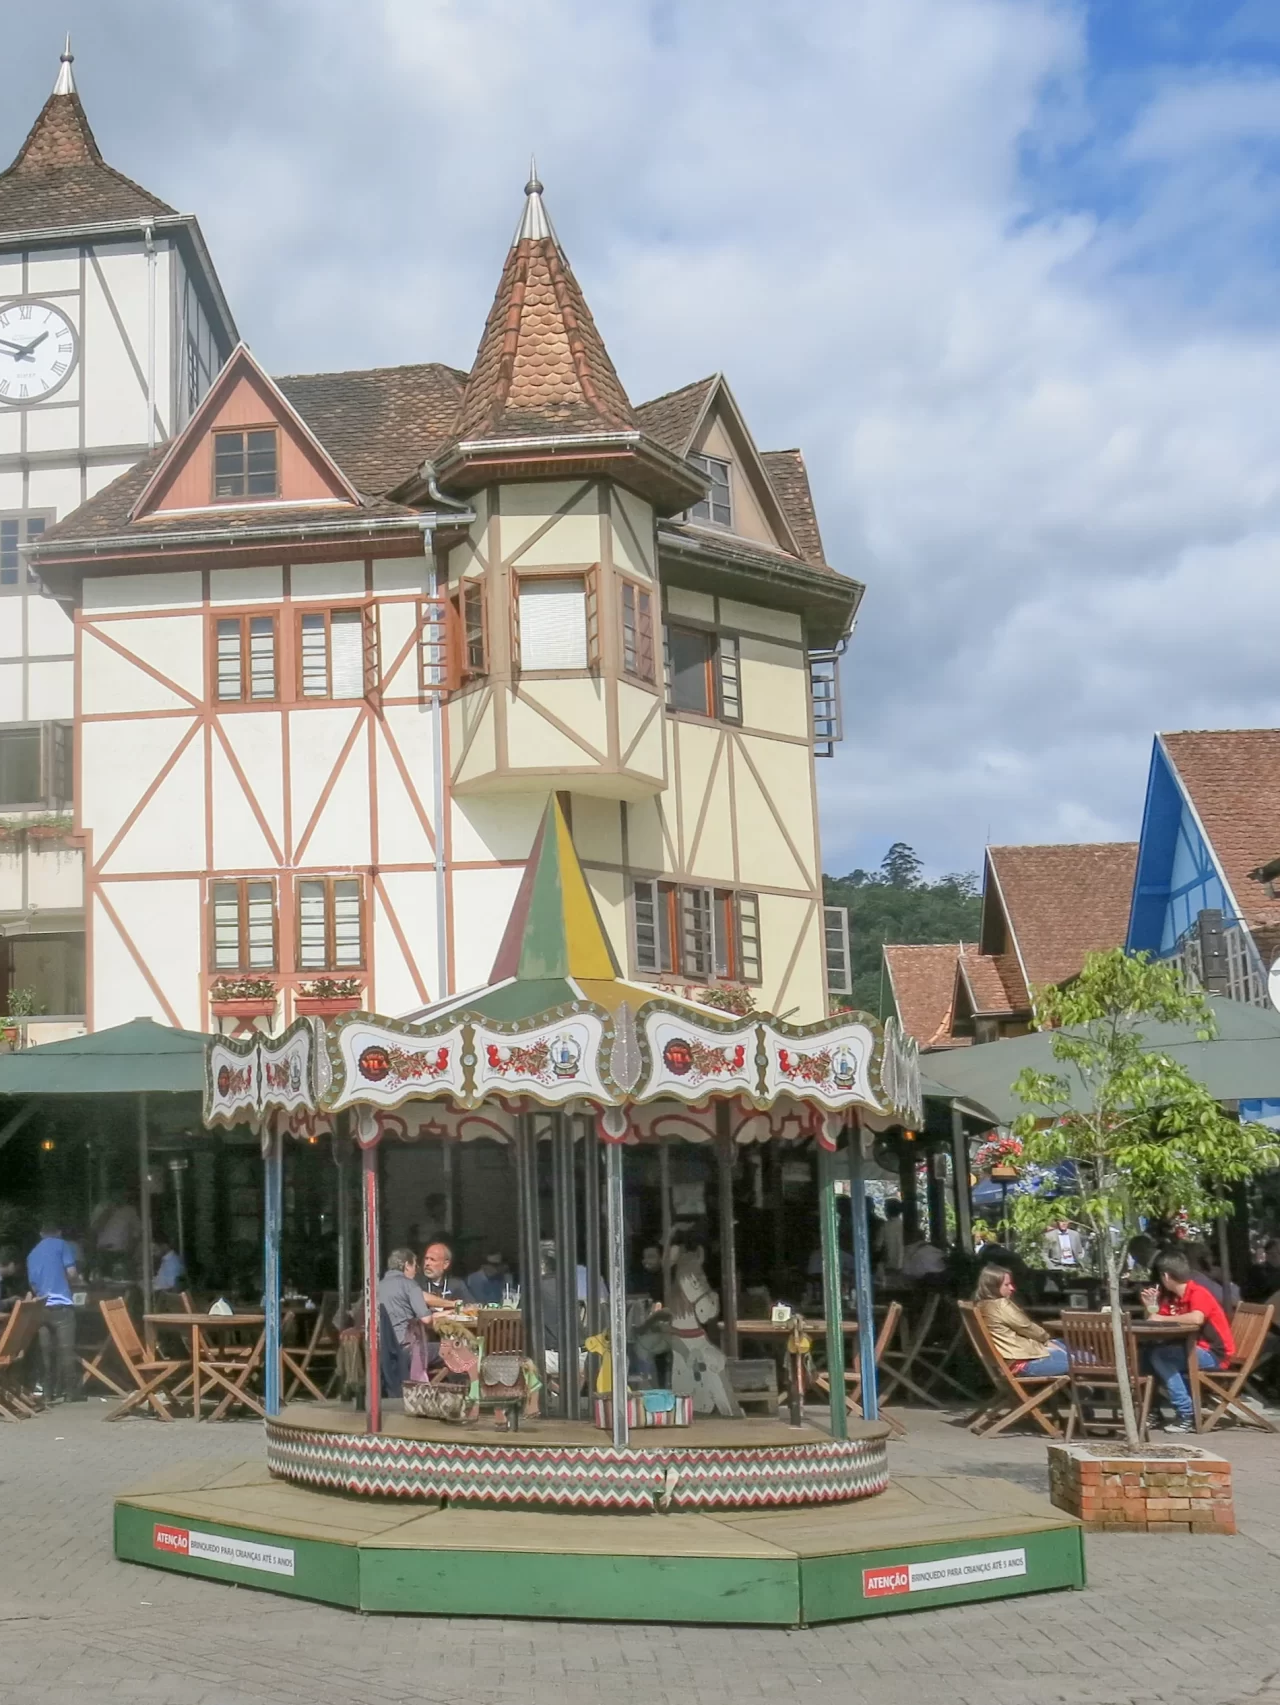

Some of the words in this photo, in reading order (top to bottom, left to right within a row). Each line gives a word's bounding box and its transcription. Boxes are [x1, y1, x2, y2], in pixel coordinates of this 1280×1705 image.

[362, 1060, 388, 1069] VILA
[157, 1532, 188, 1548] ATENÇÃO
[191, 1540, 220, 1554] BRINQUEDO
[221, 1546, 234, 1556] PARA
[236, 1549, 261, 1562] CRIANÇAS
[262, 1554, 272, 1564] ATÉ
[277, 1557, 292, 1567] ANOS
[868, 1573, 907, 1590] ATENÇÃO
[912, 1570, 945, 1582] BRINQUEDO
[947, 1567, 963, 1576] PARA
[963, 1563, 991, 1574] CRIANÇAS
[992, 1560, 1002, 1571] ATÉ
[1008, 1557, 1024, 1567] ANOS
